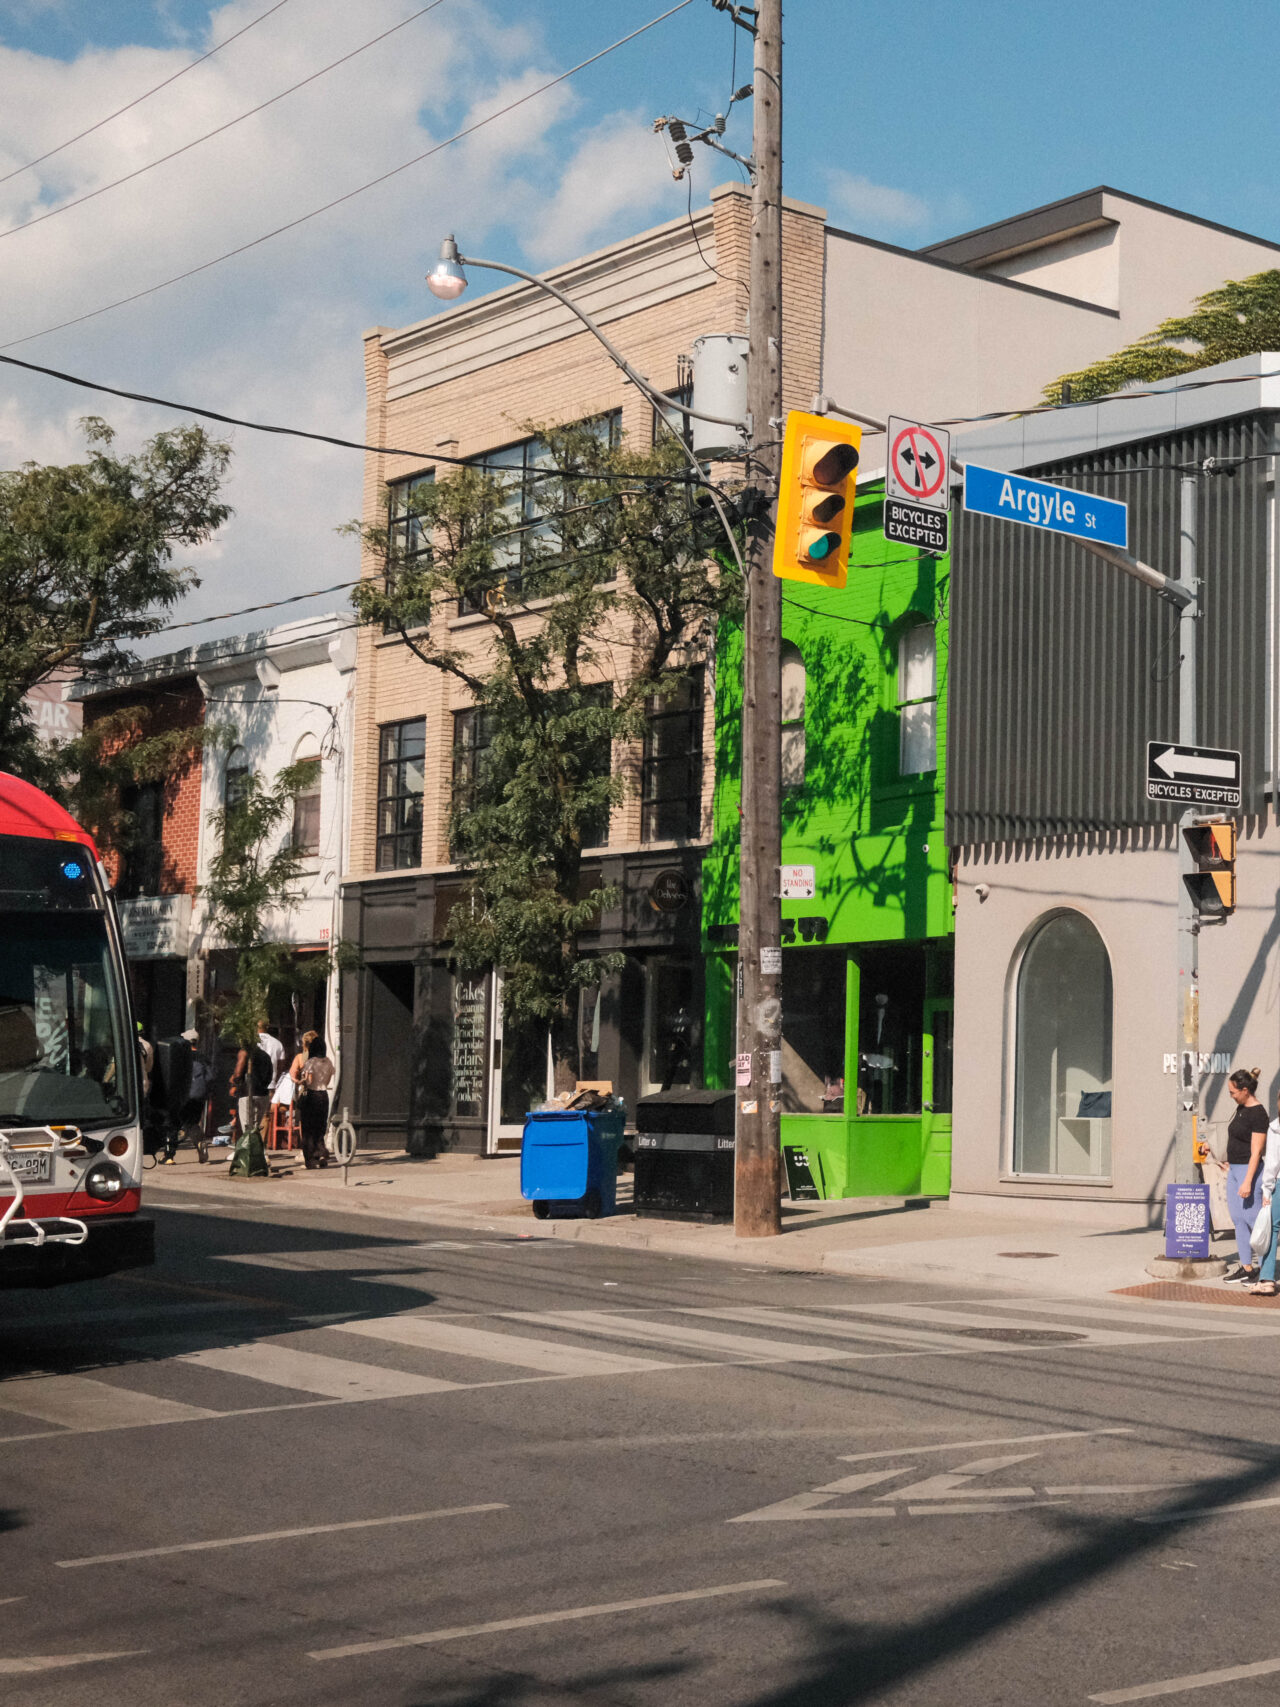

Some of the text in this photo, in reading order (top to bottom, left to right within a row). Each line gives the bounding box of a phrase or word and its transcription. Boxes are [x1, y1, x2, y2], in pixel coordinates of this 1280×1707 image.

[998, 479, 1097, 529] Argyle St
[892, 506, 941, 529] BICYCLES
[889, 522, 943, 546] EXCEPTED
[1149, 783, 1239, 803] BICYCLES EXCEPTED
[793, 869, 803, 877] NO
[783, 879, 813, 888] STANDING
[455, 981, 485, 1000] Cakes
[638, 1136, 651, 1146] Litter
[717, 1138, 735, 1149] Litter
